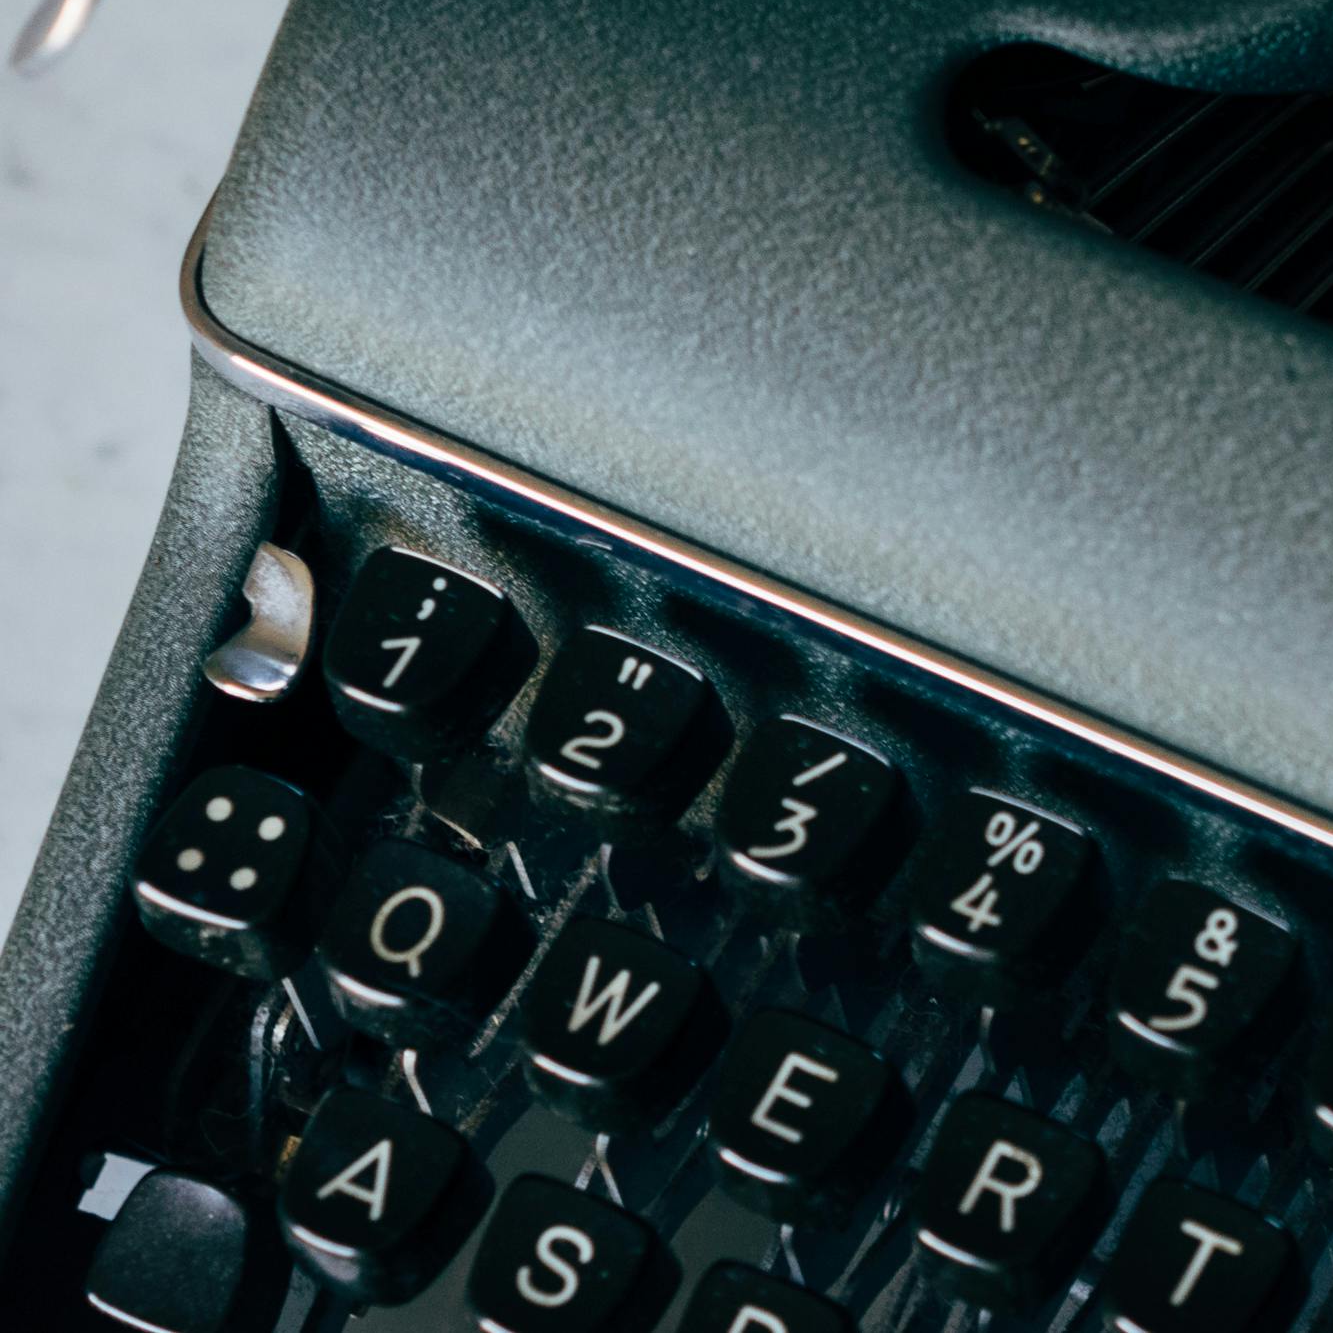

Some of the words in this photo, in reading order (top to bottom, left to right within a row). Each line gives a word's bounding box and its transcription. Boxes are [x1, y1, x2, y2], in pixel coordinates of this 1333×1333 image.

[381, 636, 421, 688] 1
[561, 710, 625, 769] 2
[748, 798, 817, 858] 3
[985, 812, 1045, 875] %
[371, 886, 444, 977] Q
[951, 874, 1001, 932] 4
[1194, 908, 1238, 966] &
[568, 956, 660, 1044] W
[1149, 965, 1219, 1030] 5
[752, 1052, 838, 1143] E
[317, 1139, 392, 1221] A
[960, 1141, 1042, 1231] R
[517, 1225, 594, 1307] S
[1172, 1220, 1242, 1305] T
